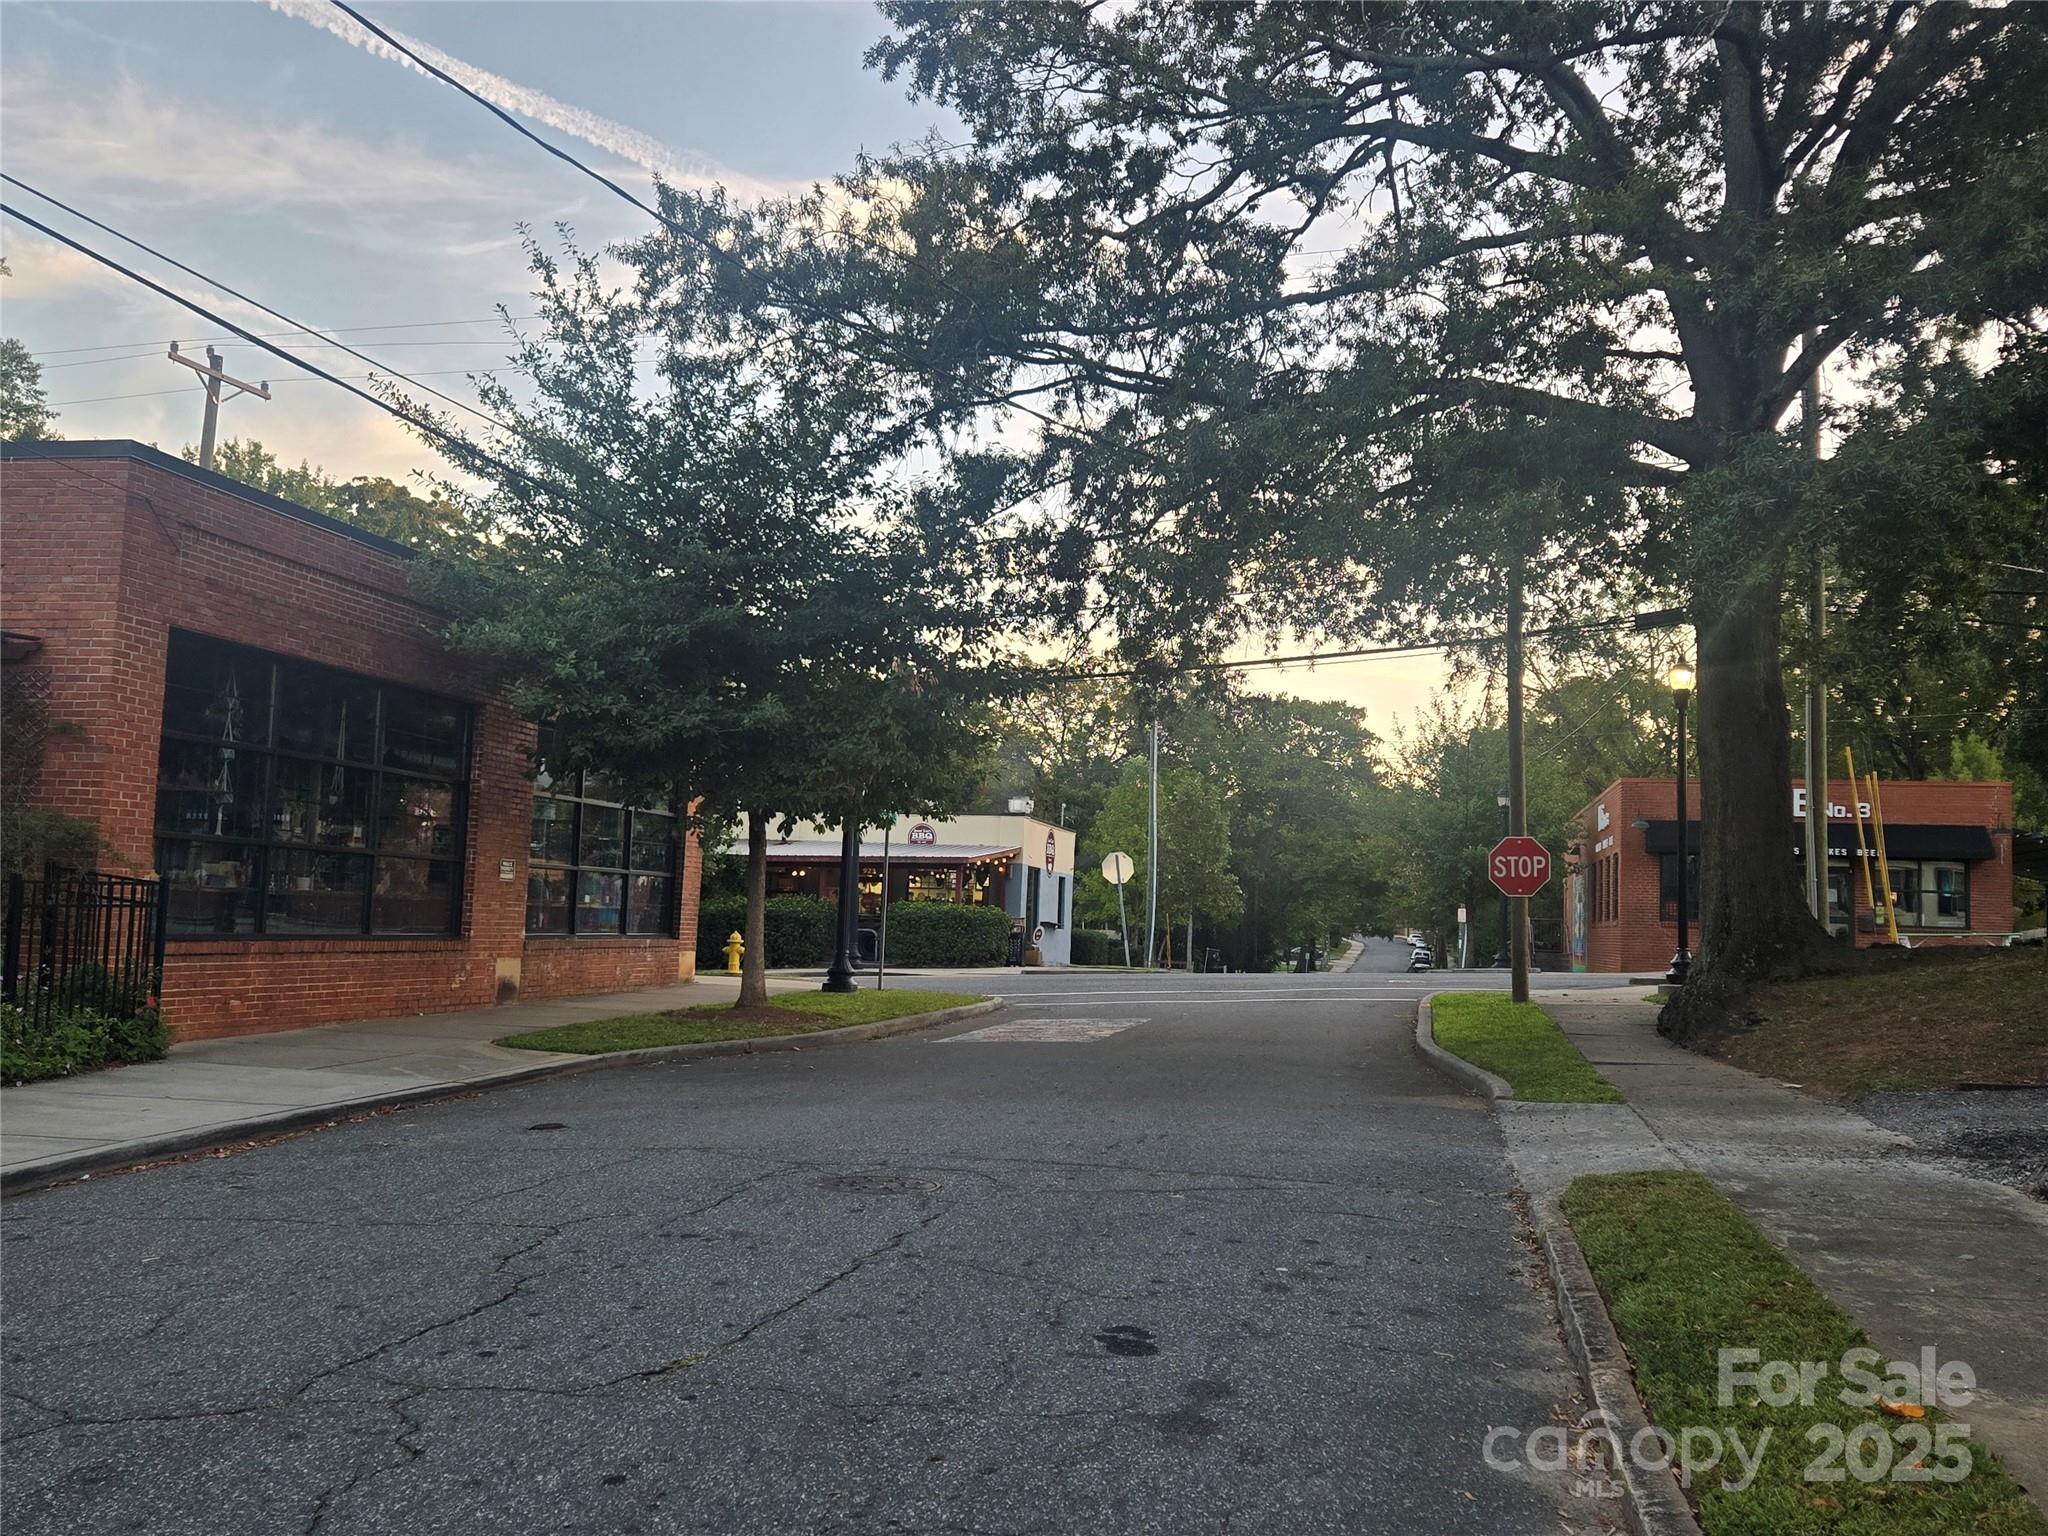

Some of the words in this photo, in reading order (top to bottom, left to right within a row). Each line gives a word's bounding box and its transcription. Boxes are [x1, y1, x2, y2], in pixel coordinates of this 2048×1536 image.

[1856, 802, 1871, 818] 3
[911, 832, 934, 840] BBQ
[1828, 848, 1848, 856] KES
[1493, 855, 1546, 878] STOP
